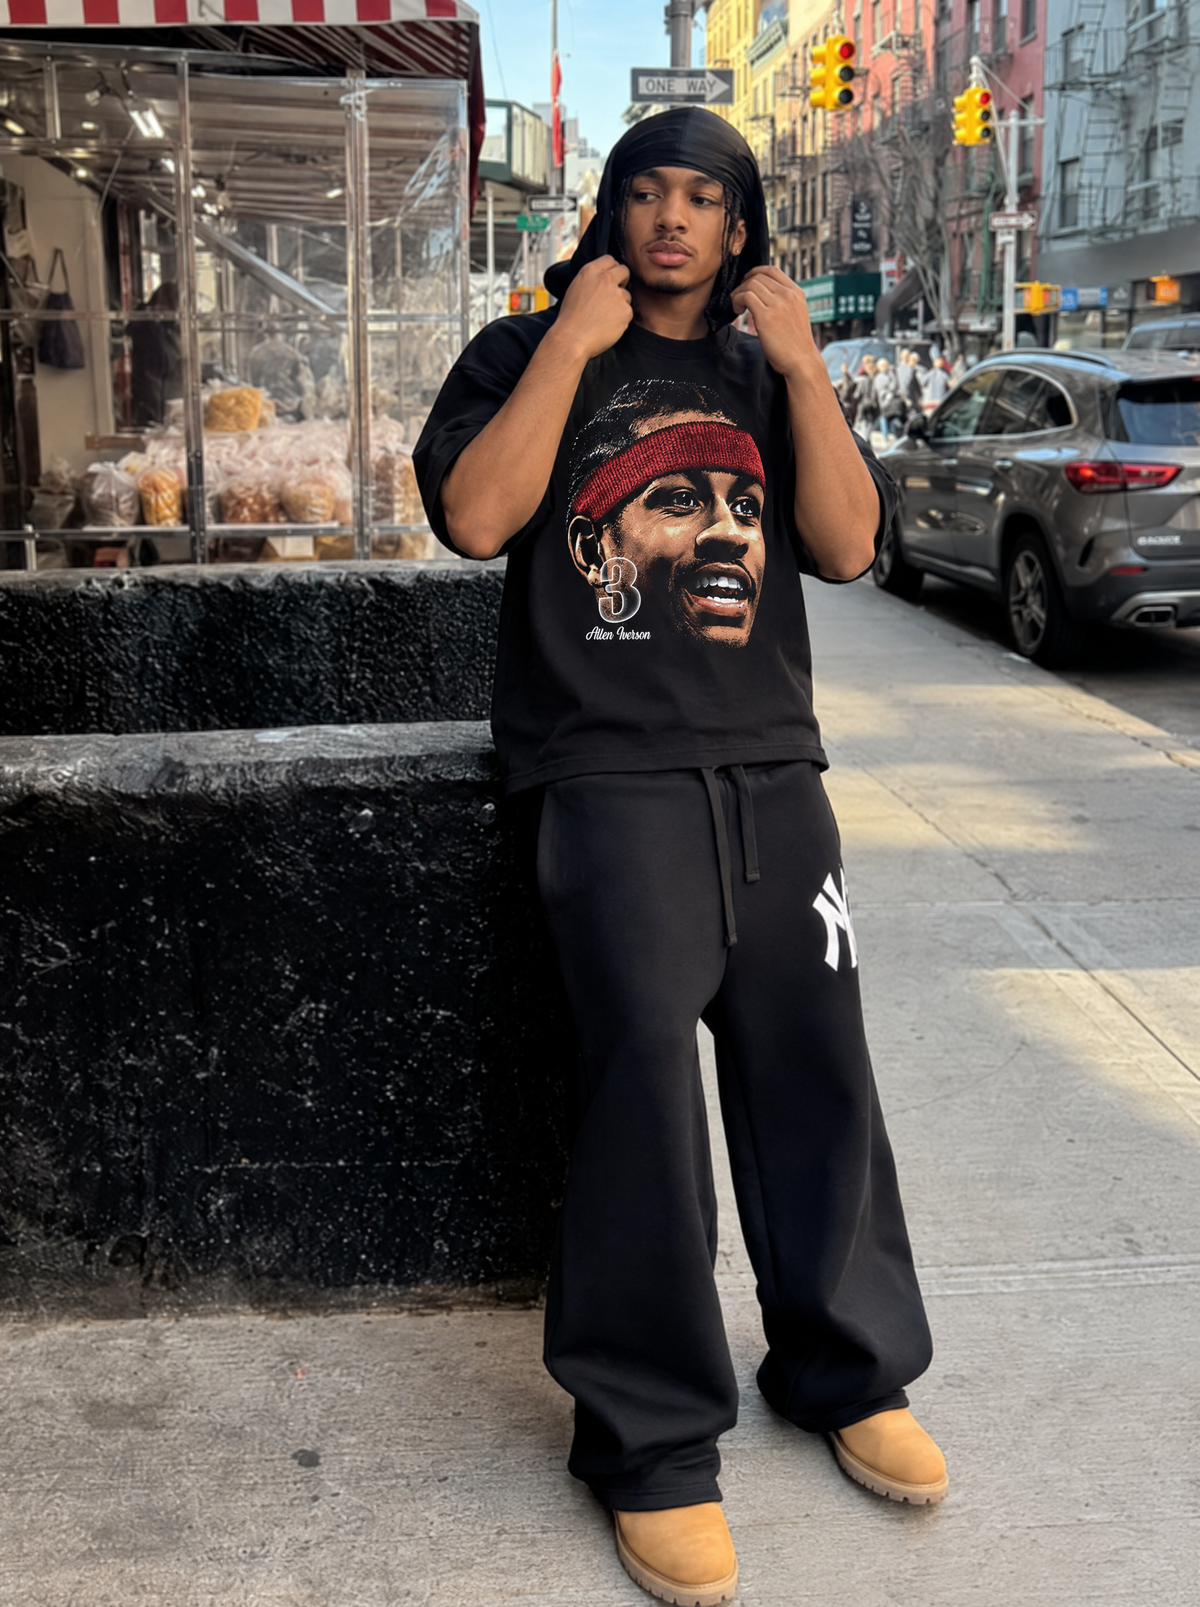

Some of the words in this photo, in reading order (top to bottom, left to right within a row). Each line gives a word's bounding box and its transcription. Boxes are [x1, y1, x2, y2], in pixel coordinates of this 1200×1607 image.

[645, 79, 676, 92] ONE
[686, 79, 717, 93] WAY
[599, 557, 641, 623] 3
[617, 626, 651, 640] Iverson
